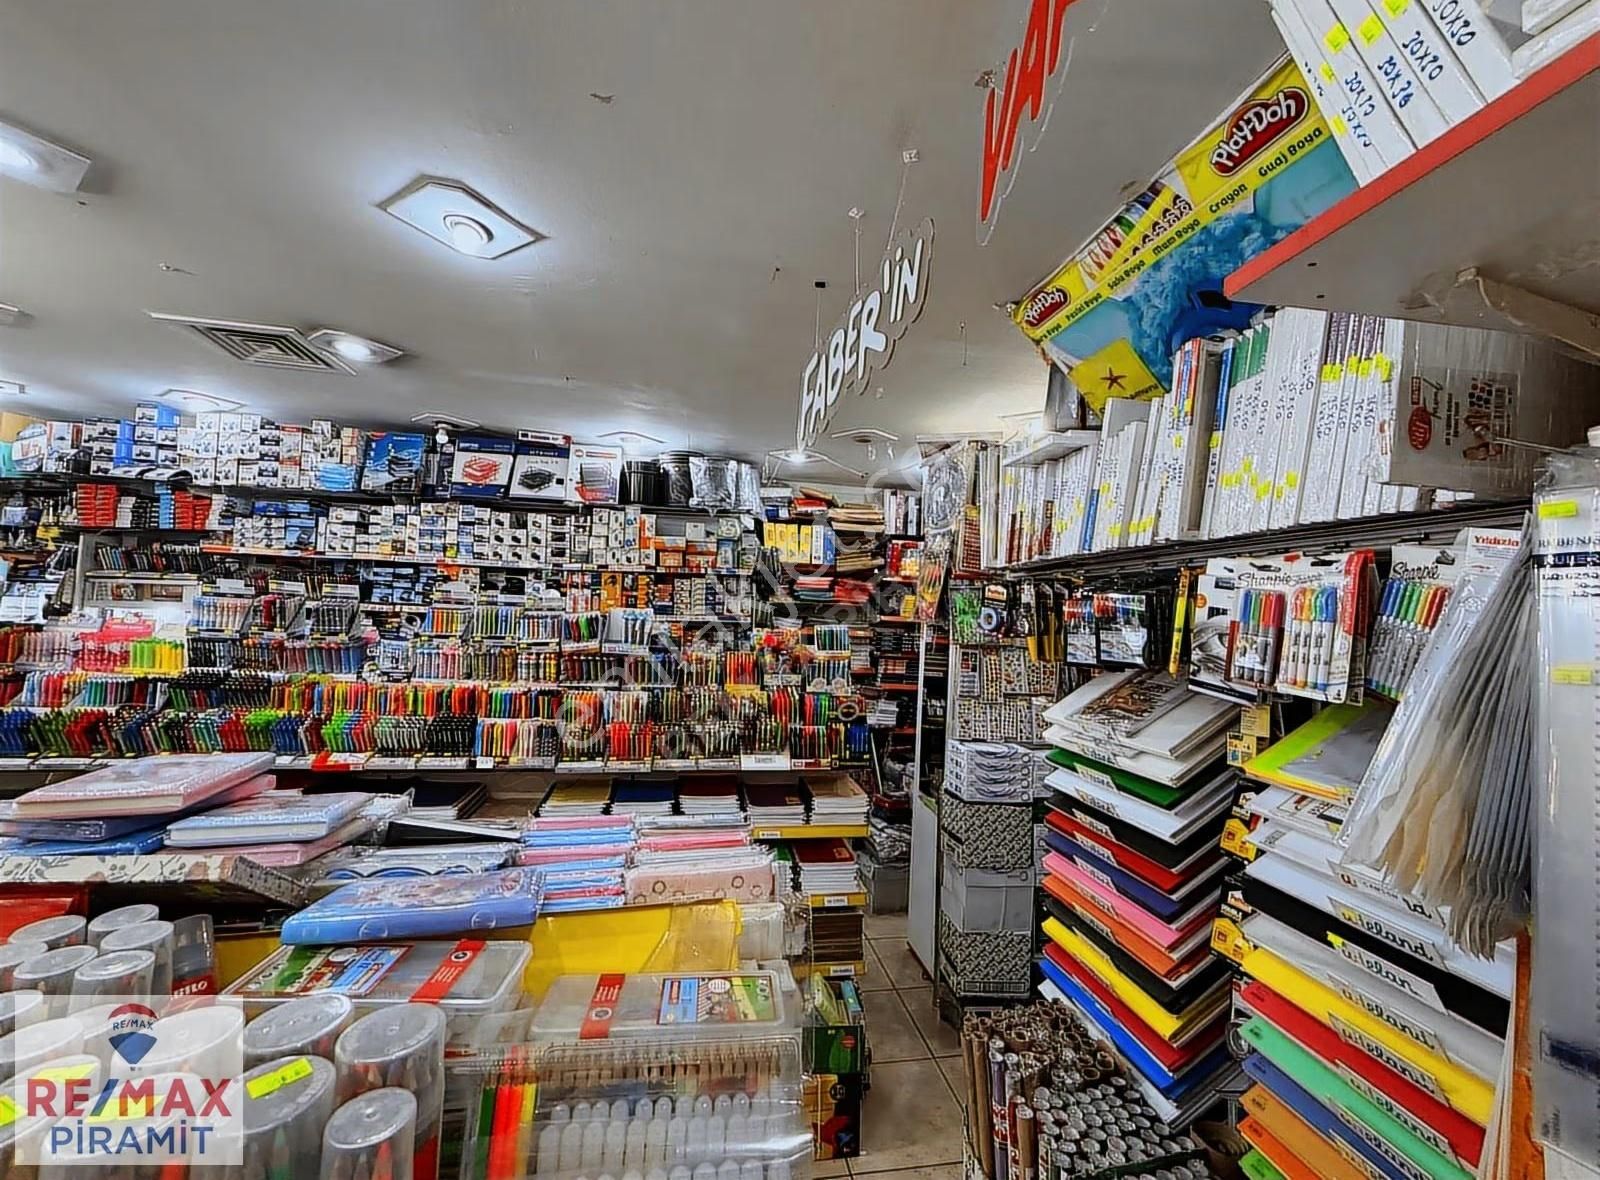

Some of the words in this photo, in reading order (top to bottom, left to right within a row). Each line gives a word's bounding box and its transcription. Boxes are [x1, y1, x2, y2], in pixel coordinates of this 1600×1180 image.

[1212, 92, 1296, 167] Play-Doh
[1208, 183, 1249, 214] Crayon
[1257, 151, 1288, 177] Guaj
[1287, 127, 1323, 155] Boya
